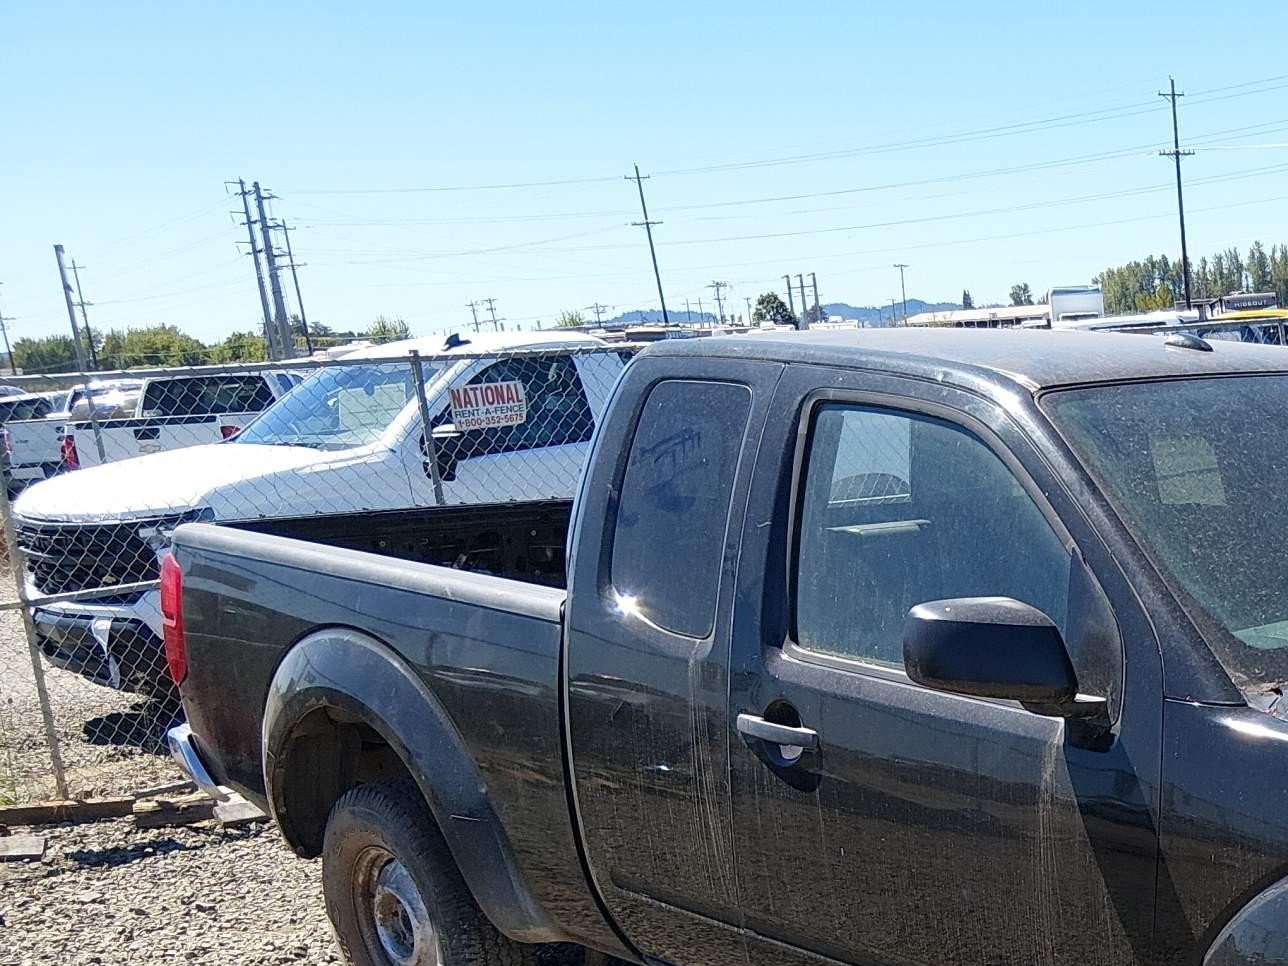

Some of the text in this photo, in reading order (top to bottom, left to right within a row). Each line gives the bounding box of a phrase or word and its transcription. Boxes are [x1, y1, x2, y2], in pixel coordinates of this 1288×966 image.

[451, 383, 523, 409] NATIONAL
[454, 403, 524, 419] RENT-A-FENCE
[458, 413, 524, 428] 1-800-352-5675
